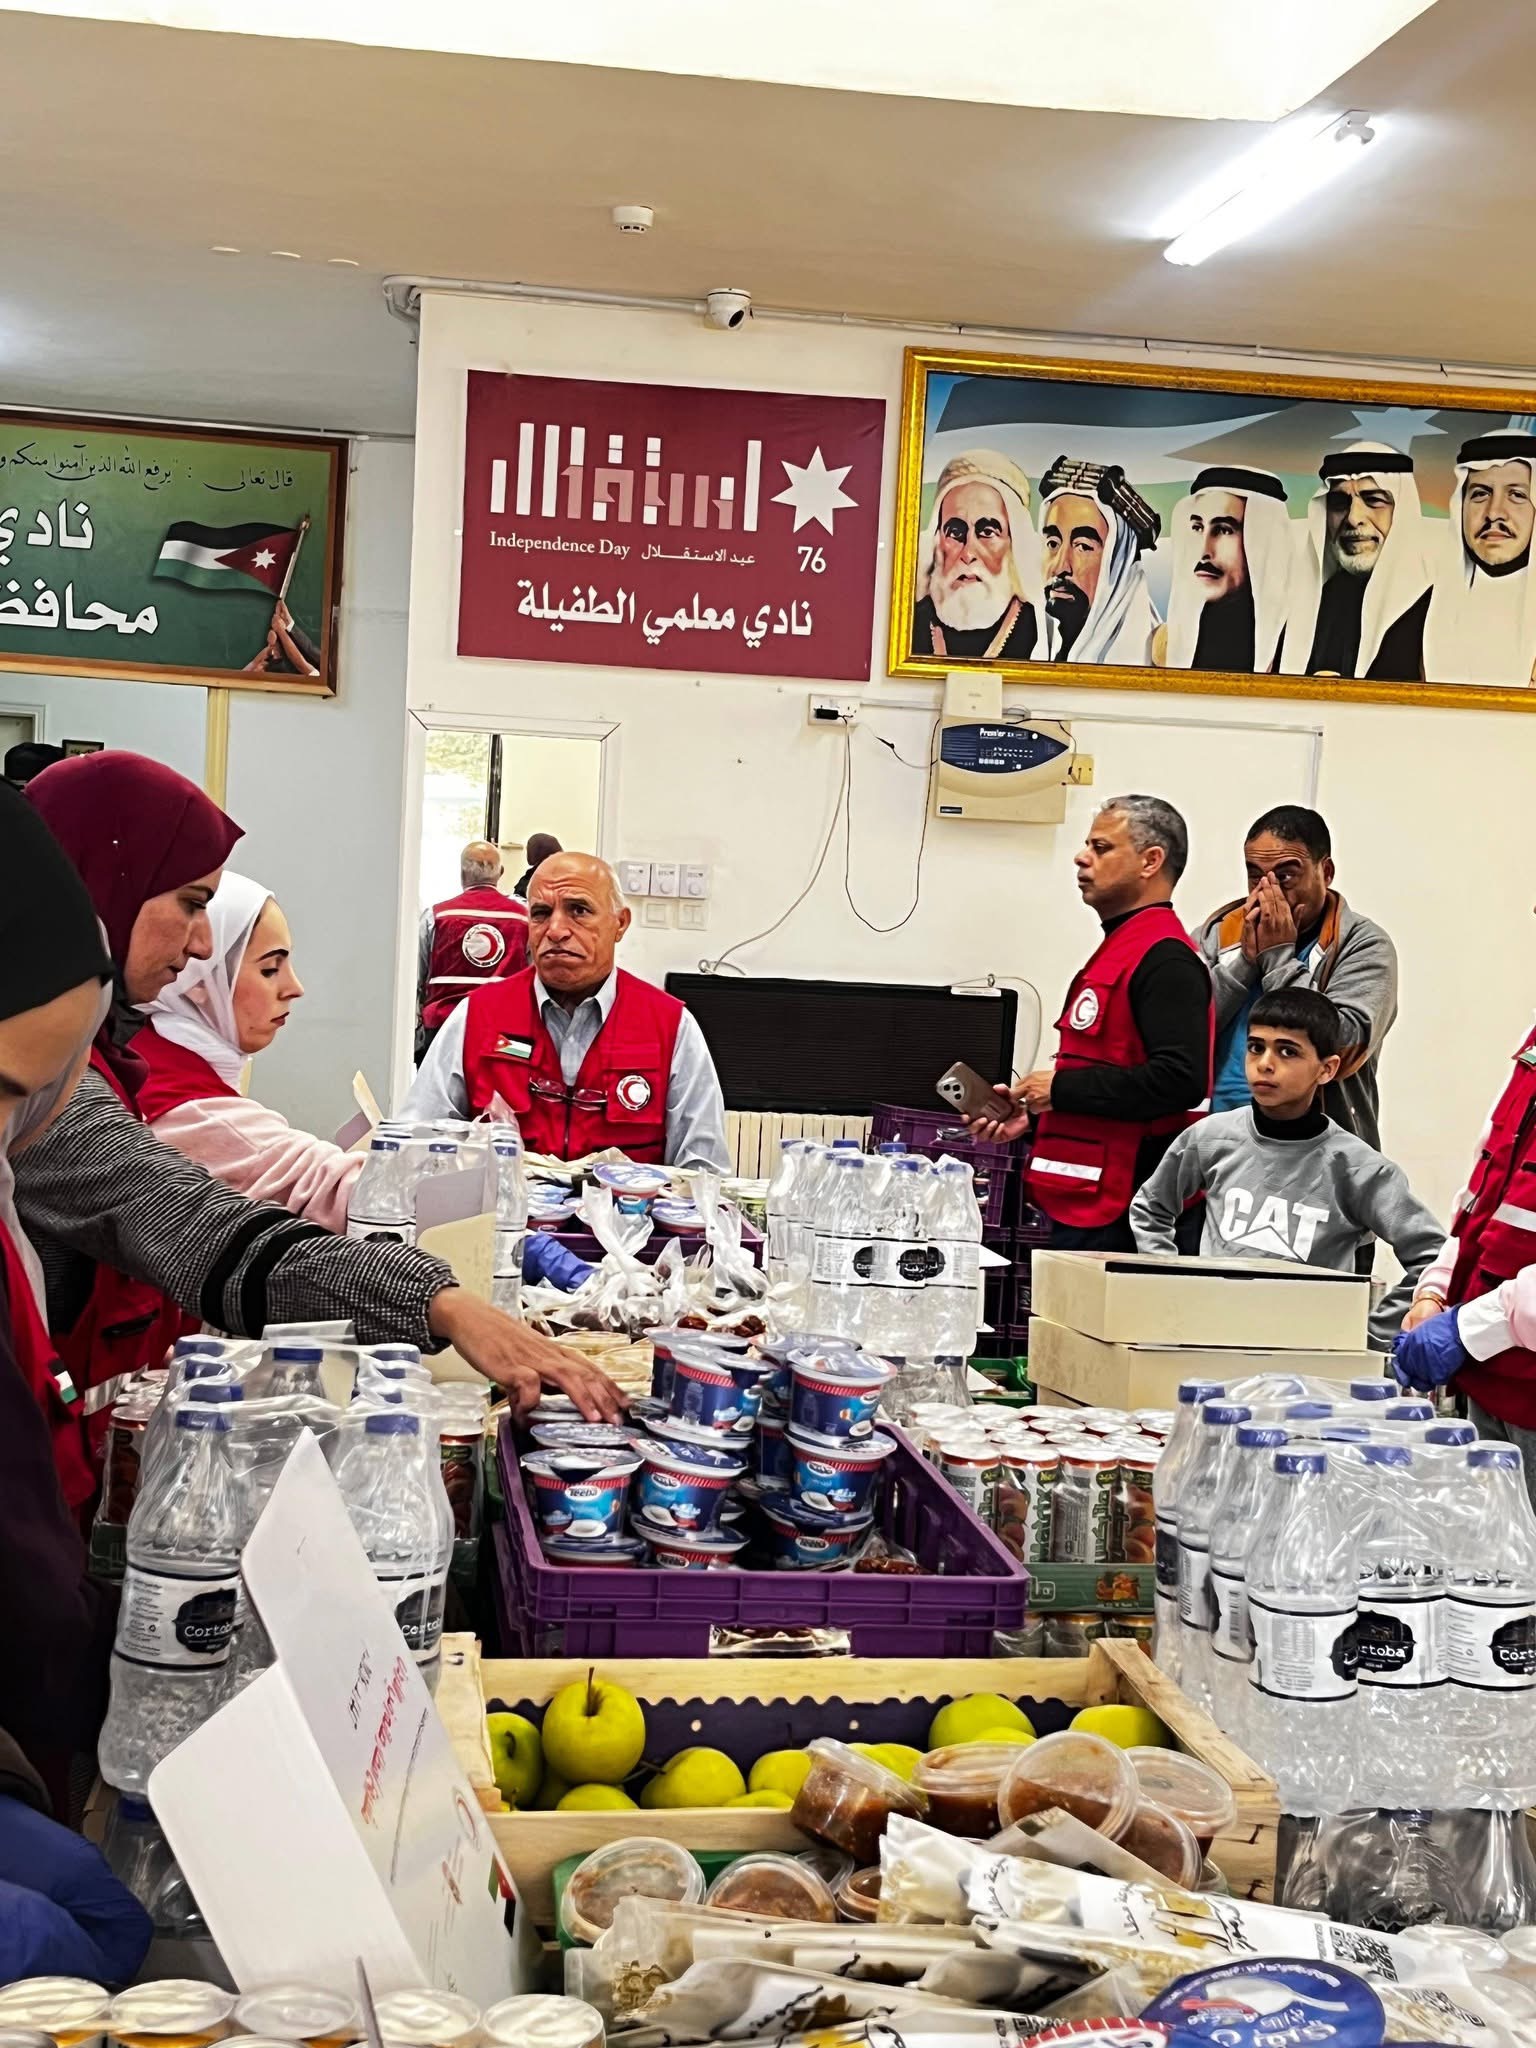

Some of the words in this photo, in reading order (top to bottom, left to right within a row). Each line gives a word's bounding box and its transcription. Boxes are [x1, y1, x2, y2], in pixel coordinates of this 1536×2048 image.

[9, 442, 48, 475] منكم
[119, 445, 141, 474] الله
[269, 470, 294, 490] قال
[489, 531, 595, 553] Independence
[599, 539, 630, 561] Day
[729, 553, 755, 567] عيد
[797, 546, 826, 573] 76
[517, 579, 635, 632] الطفيلة
[642, 592, 736, 645] معلمي
[742, 600, 812, 648] نادي
[1219, 1187, 1330, 1263] CAT
[569, 1487, 598, 1497] Teeba
[1360, 1644, 1406, 1657] rtoba
